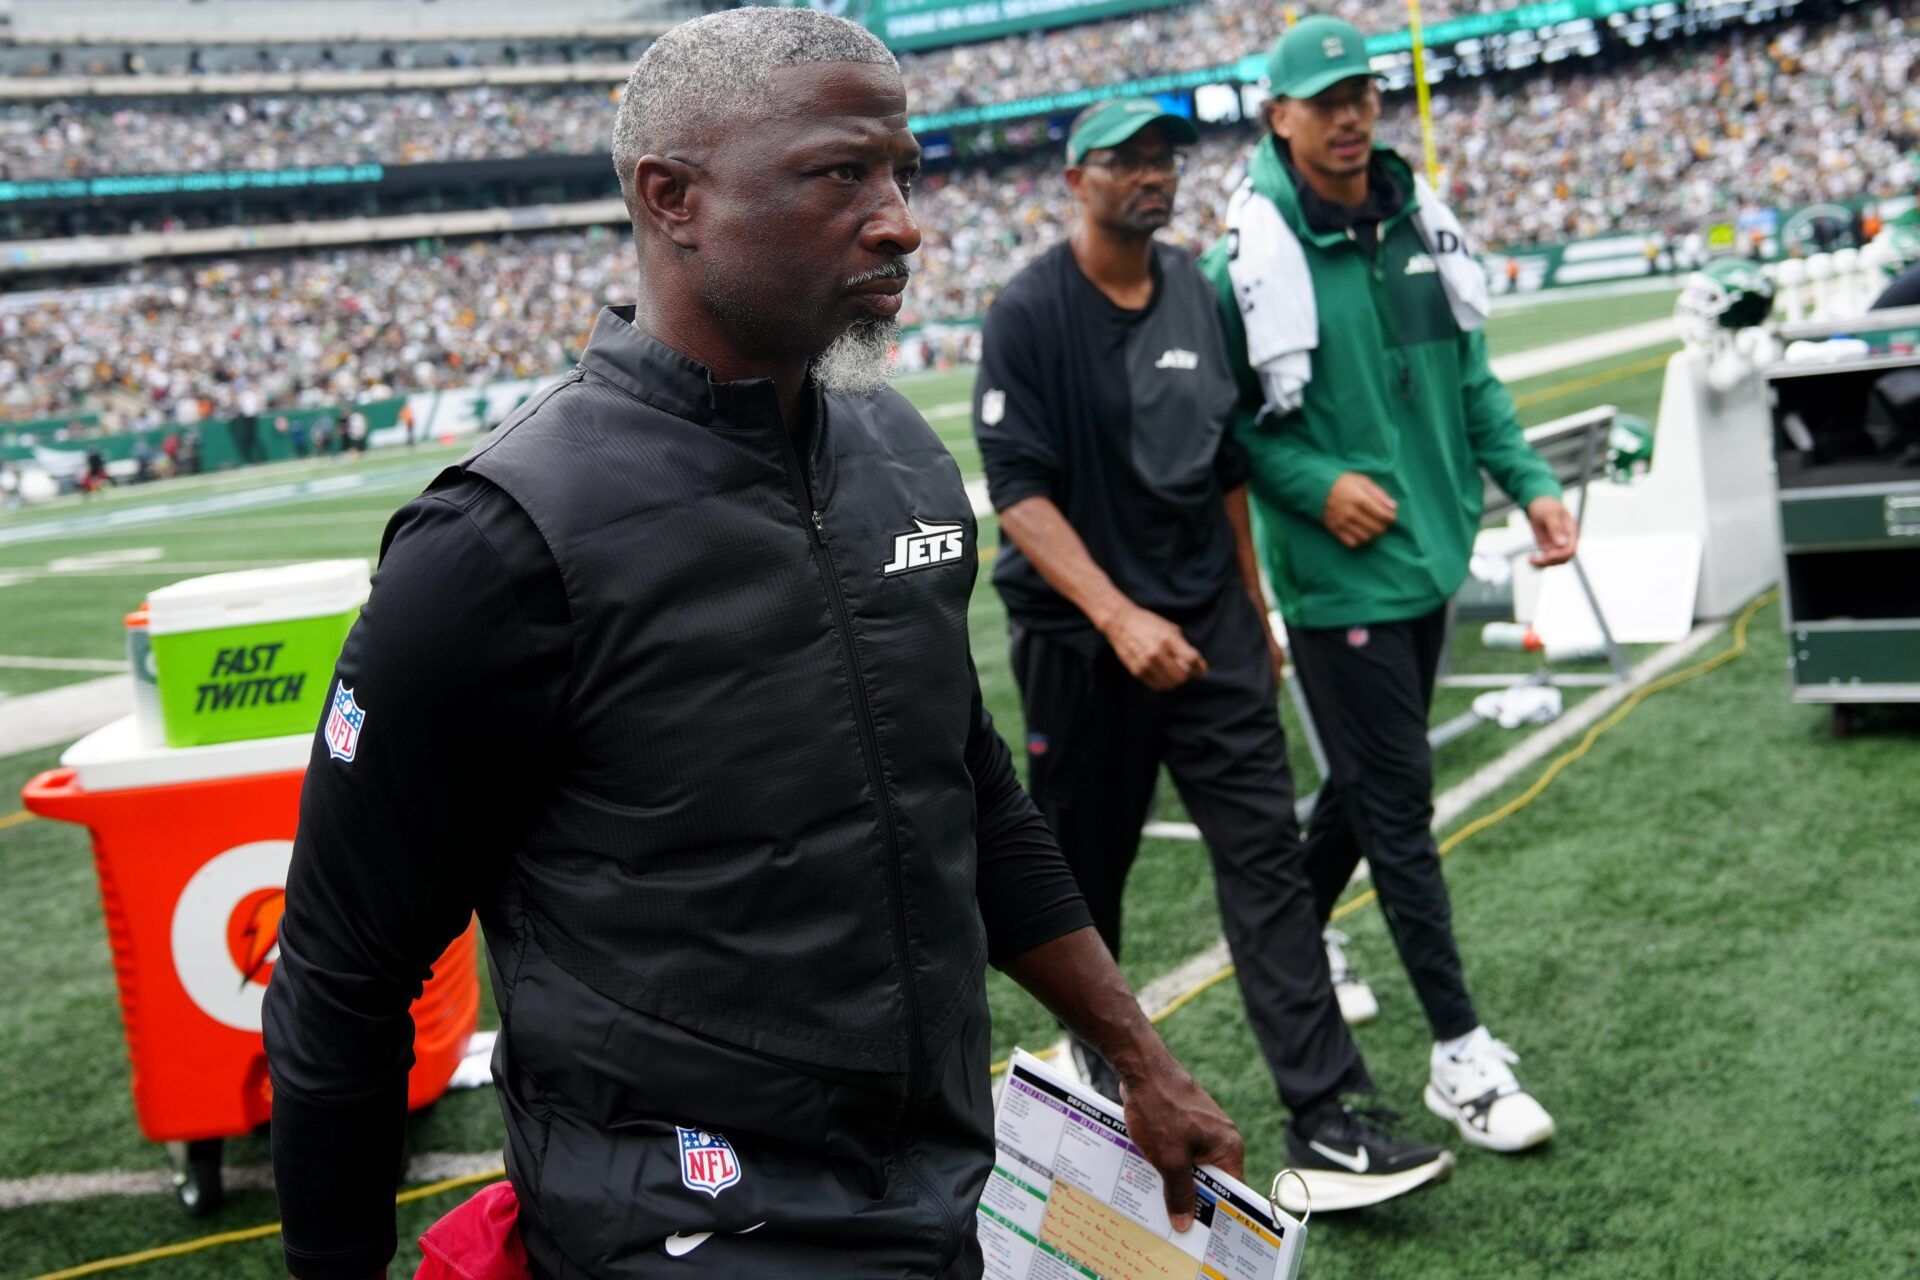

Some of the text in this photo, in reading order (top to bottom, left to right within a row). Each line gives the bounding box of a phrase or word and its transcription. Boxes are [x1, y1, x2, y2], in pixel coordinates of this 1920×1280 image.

[884, 518, 963, 574] JETS
[210, 641, 285, 678] FAST
[195, 672, 307, 714] TWITCH
[328, 709, 354, 754] NFL
[1066, 1095, 1101, 1119] DEFENSE
[1102, 1116, 1112, 1125] vs
[688, 1149, 735, 1183] NFL
[1191, 1167, 1207, 1182] LAN
